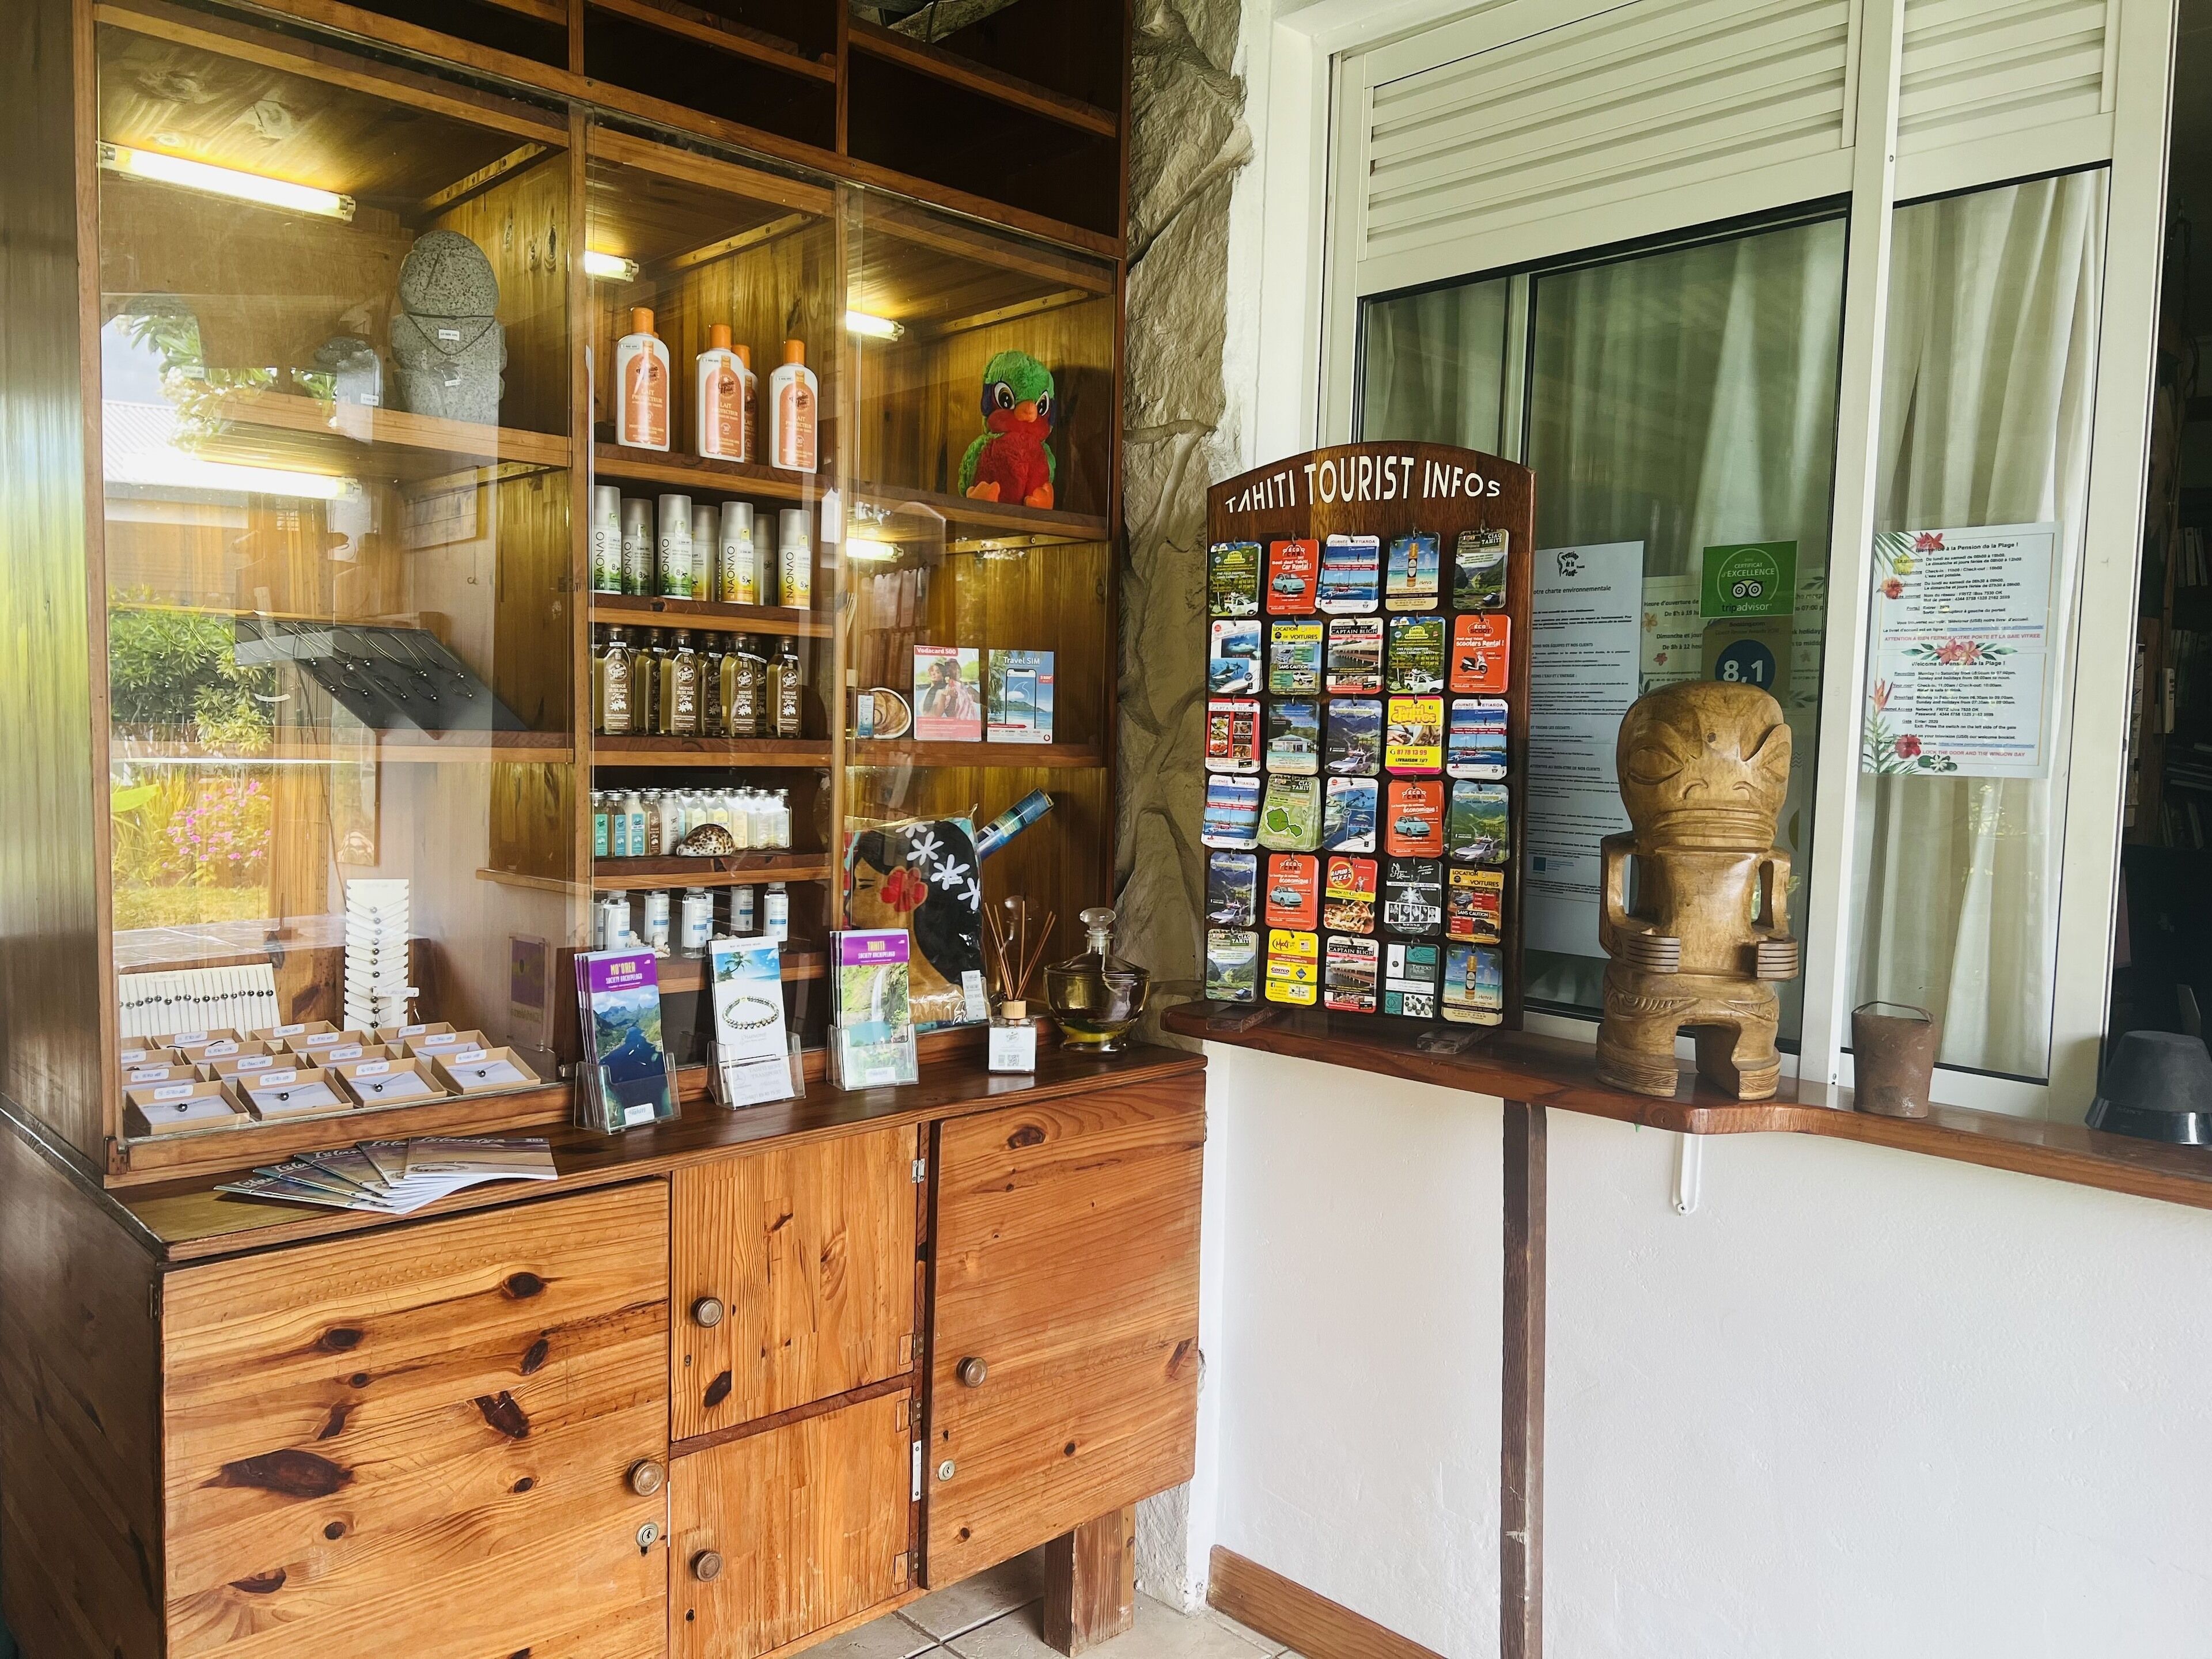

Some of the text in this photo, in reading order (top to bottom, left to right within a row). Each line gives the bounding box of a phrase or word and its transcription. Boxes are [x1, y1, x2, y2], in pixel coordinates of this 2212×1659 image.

[1225, 469, 1295, 513] TAHITI
[1304, 455, 1414, 505] TOURIST
[1563, 585, 1611, 593] environnementale
[1722, 603, 1770, 613] tripadvisor
[1003, 656, 1025, 664] Travel
[1332, 874, 1352, 882] PIZZA
[610, 961, 636, 976] MO'OREA
[605, 976, 620, 984] SOCIETY
